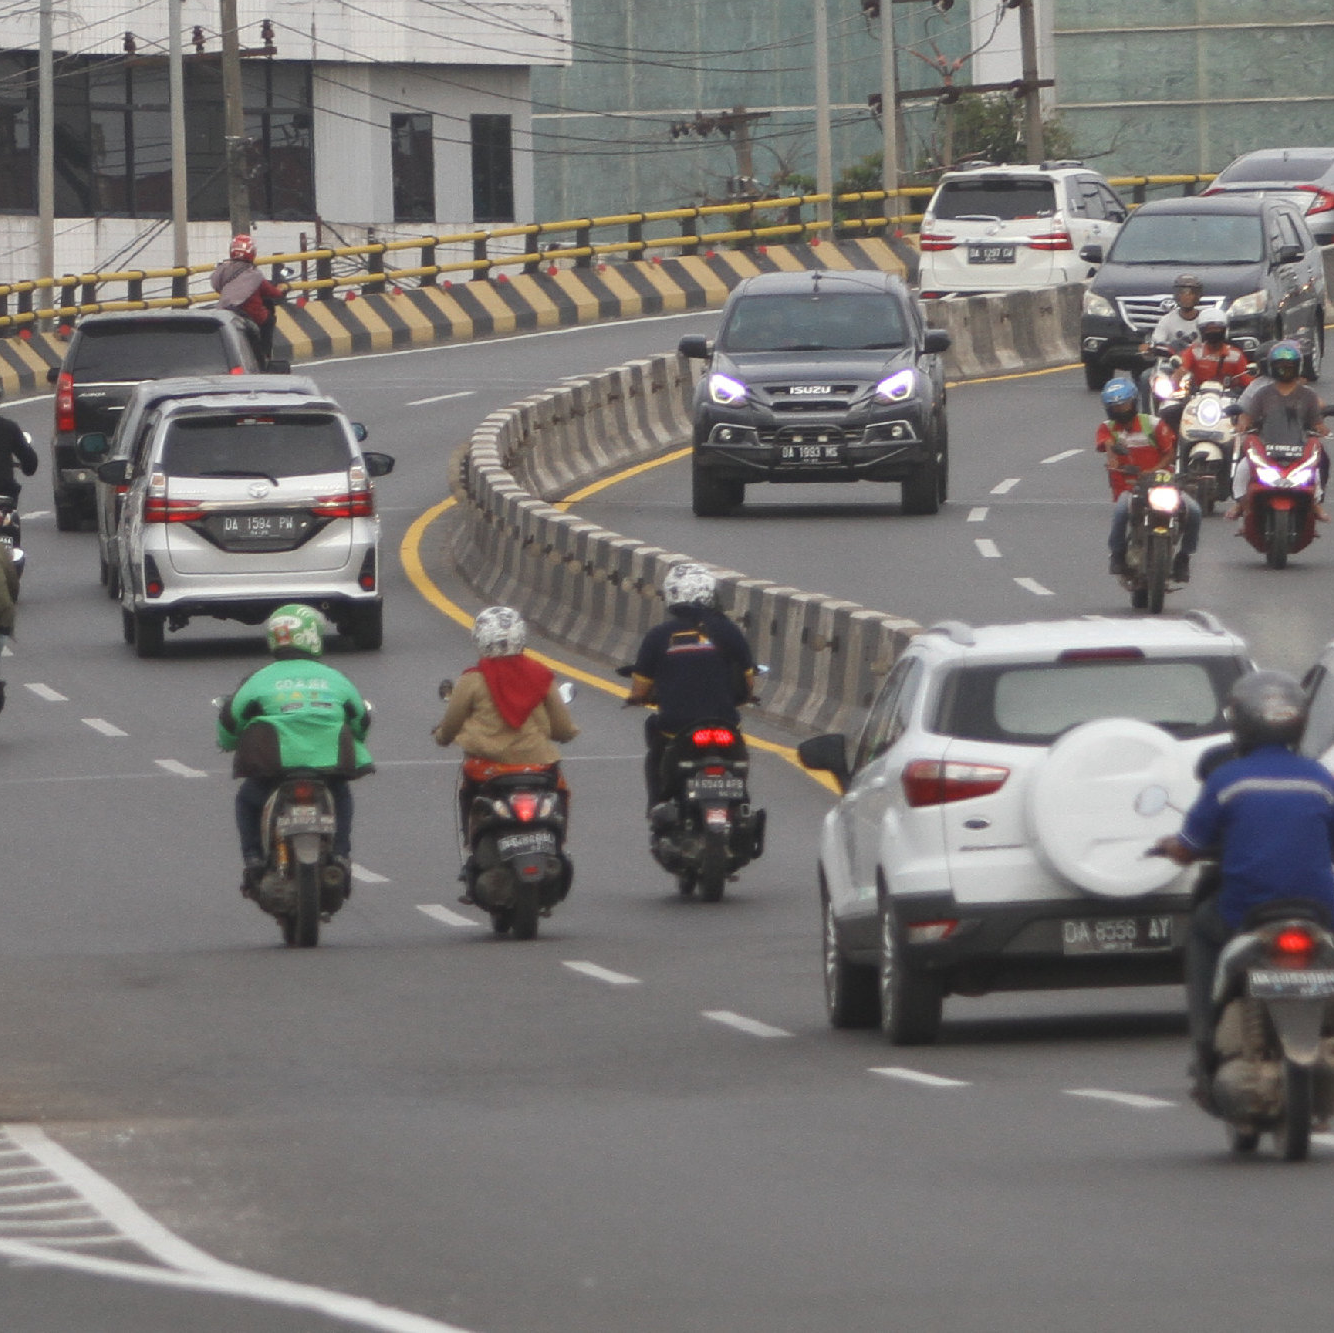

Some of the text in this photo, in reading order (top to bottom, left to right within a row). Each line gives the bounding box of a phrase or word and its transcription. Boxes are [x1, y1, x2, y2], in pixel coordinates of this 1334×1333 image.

[789, 385, 832, 395] ISUZU
[225, 517, 238, 531] DA
[1064, 921, 1090, 944] DA
[1147, 918, 1170, 939] AY
